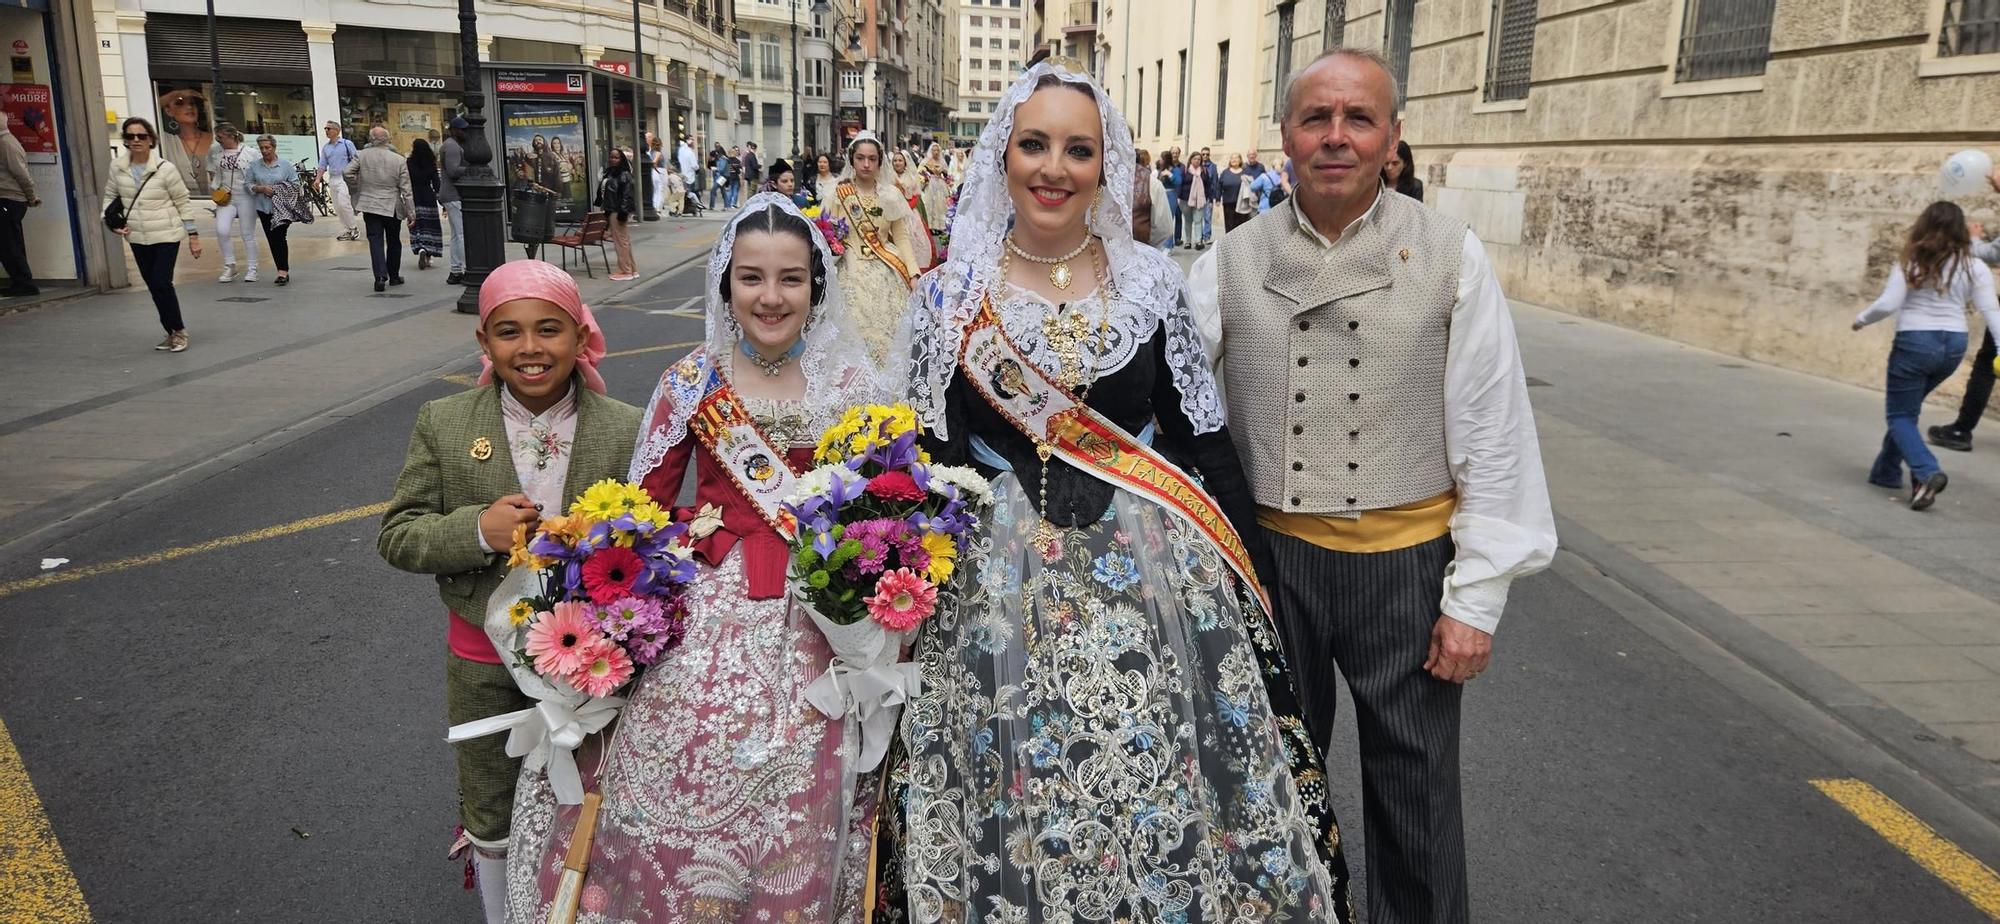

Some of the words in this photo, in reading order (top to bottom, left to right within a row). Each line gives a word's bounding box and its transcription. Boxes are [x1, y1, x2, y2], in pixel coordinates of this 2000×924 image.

[367, 75, 446, 89] VESTOPAZZO
[12, 93, 48, 103] MADRE
[508, 113, 578, 127] MATUSALÉN
[1030, 389, 1049, 417] MARZAL
